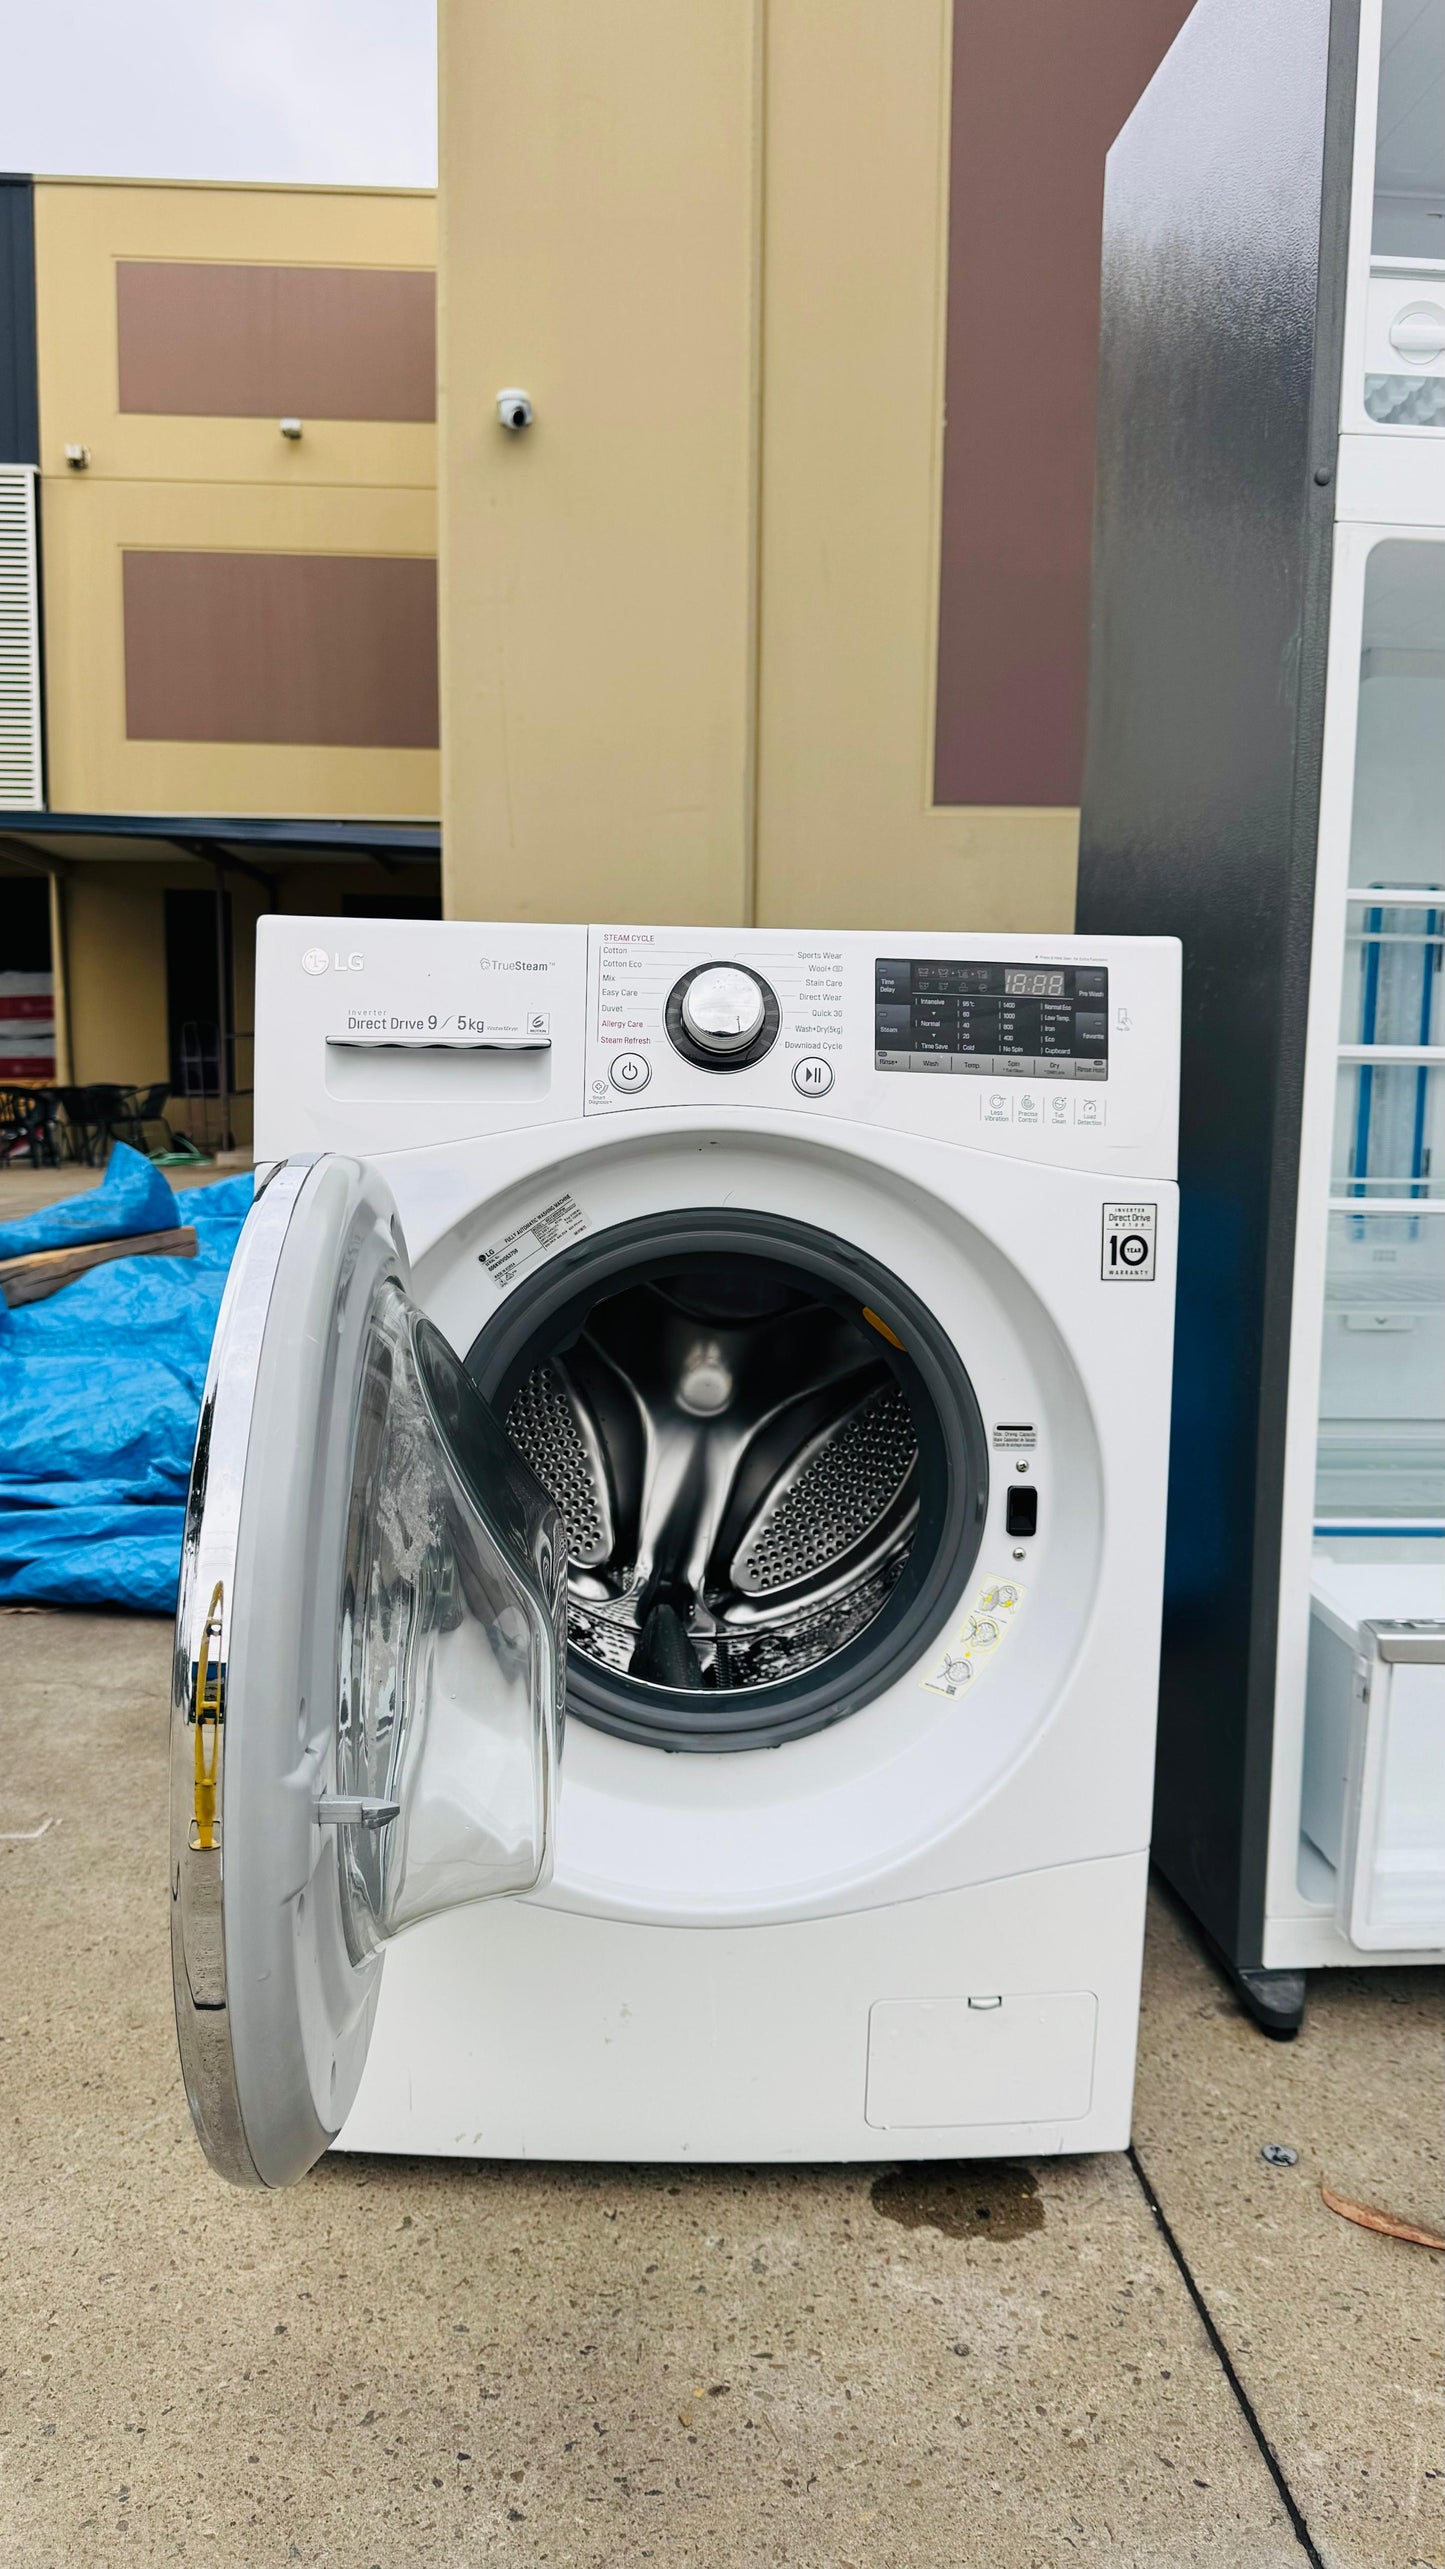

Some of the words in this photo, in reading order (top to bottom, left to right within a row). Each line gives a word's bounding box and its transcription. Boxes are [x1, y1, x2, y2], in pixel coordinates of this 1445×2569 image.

[603, 934, 630, 942] STEAM
[603, 946, 628, 954] Cotton
[797, 951, 822, 960] Sports
[822, 952, 843, 960] Wear
[334, 952, 365, 972] LG
[602, 960, 628, 968] Cotton
[602, 974, 616, 982] Mix
[881, 978, 895, 986] Time
[805, 979, 825, 987] Stain
[602, 988, 620, 997] Easy
[621, 989, 638, 997] Care
[880, 986, 896, 994] Delay
[799, 993, 821, 1001] Direct
[822, 993, 843, 1001] Wear
[920, 998, 945, 1006] Intensive
[601, 1004, 623, 1012] Duvet
[1044, 1003, 1062, 1011] Normal
[811, 1009, 832, 1017] Quick
[833, 1009, 843, 1018] 30
[348, 1017, 387, 1030] Direct
[390, 1017, 424, 1030] Drive
[601, 1020, 627, 1029] Allergy
[600, 1036, 623, 1045] Steam
[624, 1037, 651, 1045] Refresh
[784, 1041, 821, 1049] Download
[822, 1042, 843, 1051] Cycle
[1007, 1060, 1021, 1068] Spin
[1049, 1062, 1060, 1070] Dry
[1018, 1110, 1038, 1118] Precise
[1018, 1116, 1038, 1124] Control
[1108, 1213, 1131, 1222] Direct
[1131, 1213, 1151, 1222] Drive
[484, 1248, 495, 1258] LG
[1109, 1234, 1149, 1267] 10
